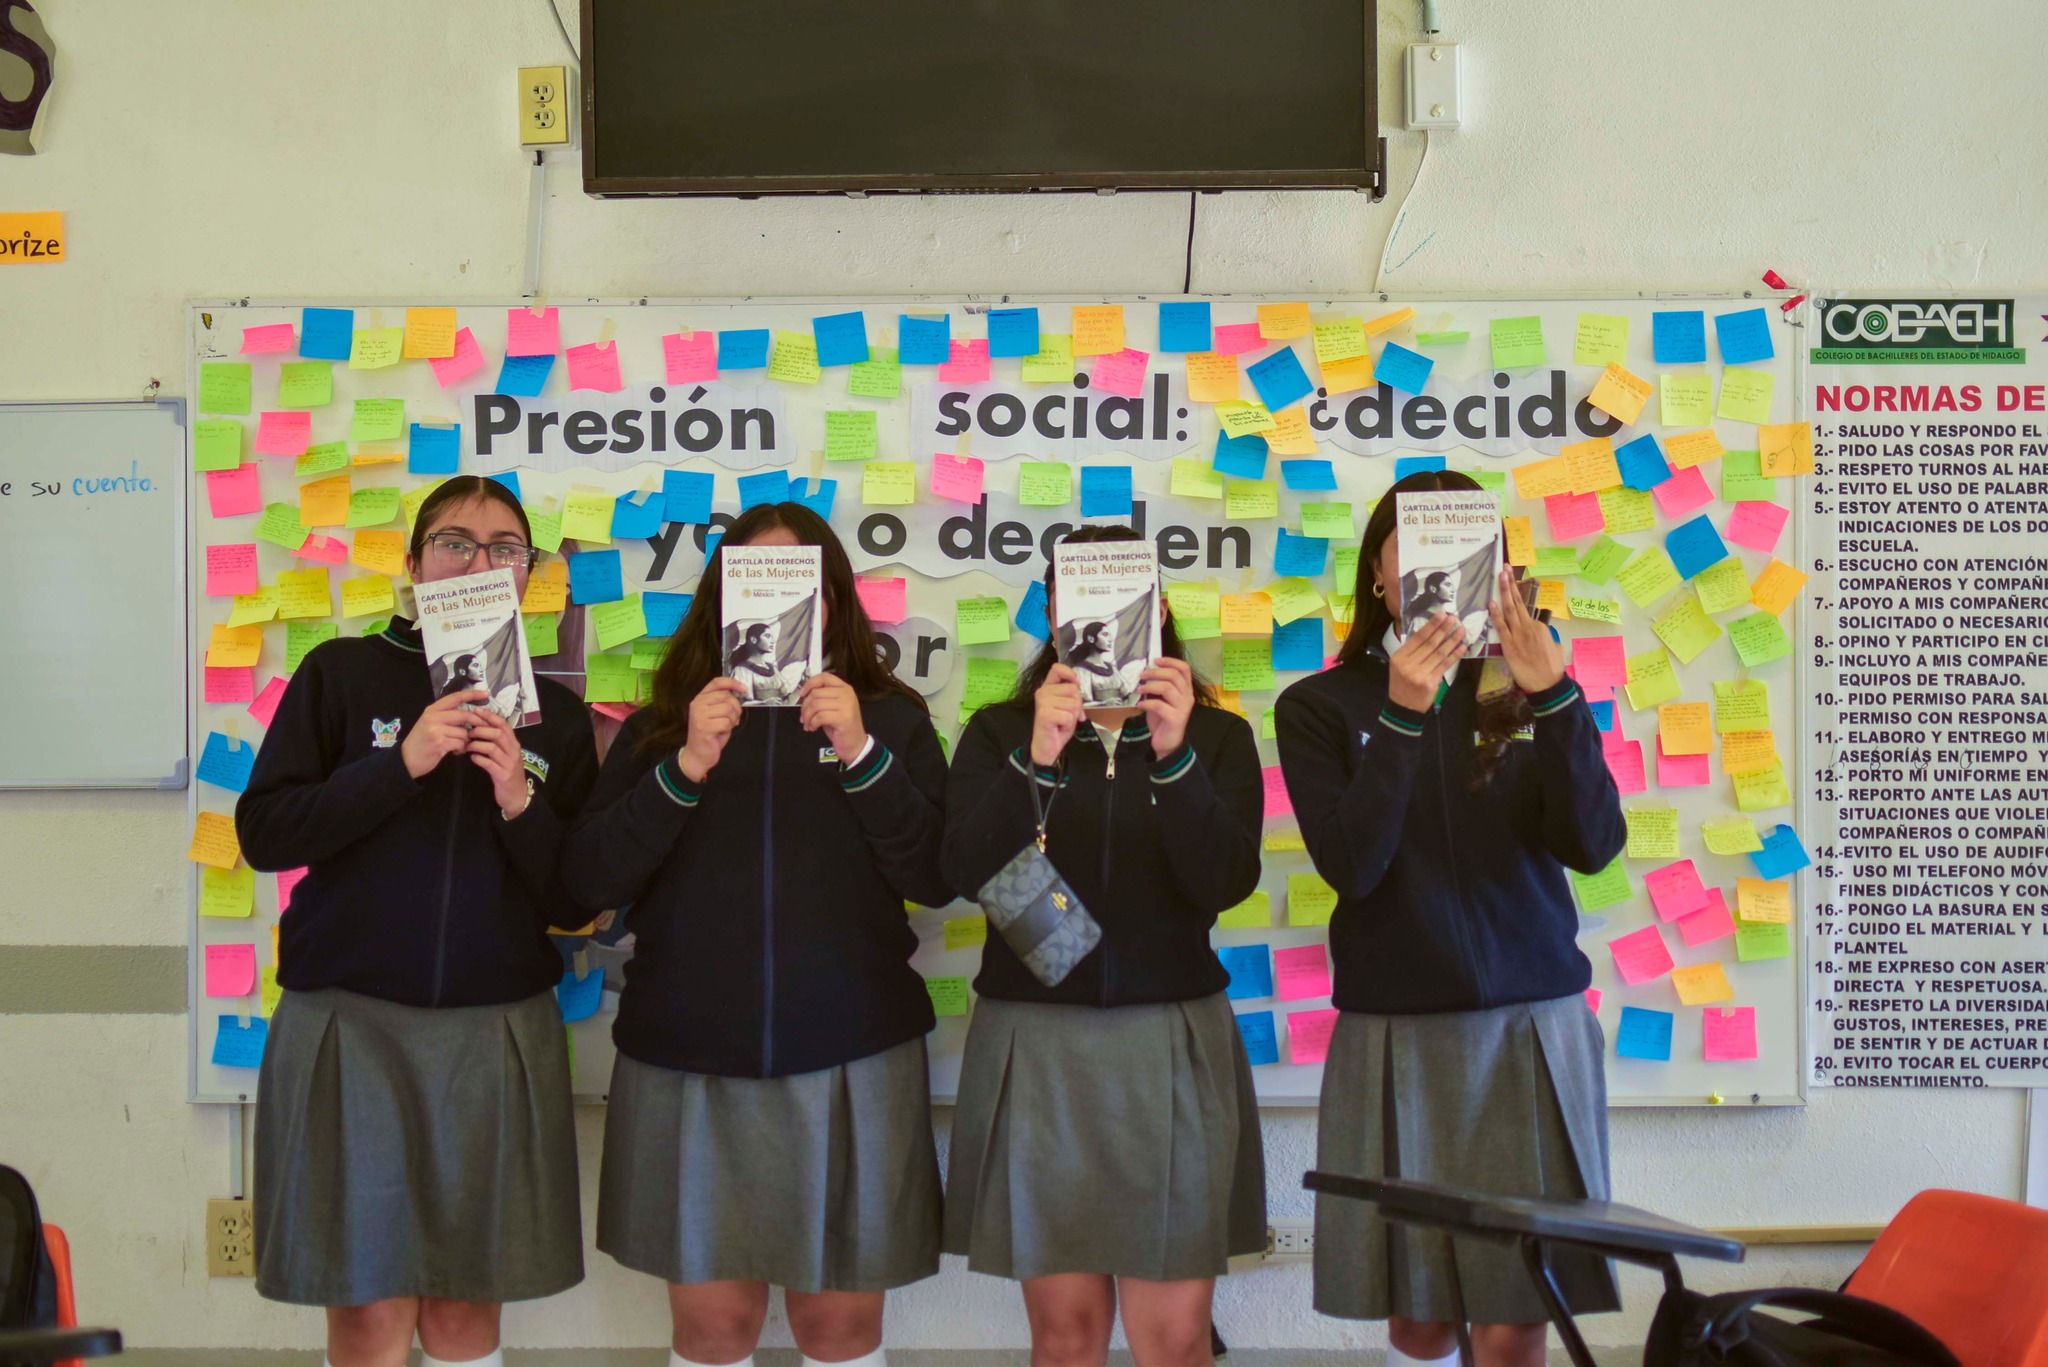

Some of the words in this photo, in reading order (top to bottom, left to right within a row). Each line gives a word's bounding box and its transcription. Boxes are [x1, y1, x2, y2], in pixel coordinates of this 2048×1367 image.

[1825, 303, 2006, 342] COBAEH
[1815, 351, 1853, 361] COLEGIO
[1855, 351, 1866, 361] DE
[1867, 351, 1918, 361] BACHILLERES
[1920, 351, 1935, 361] DEL
[1936, 351, 1968, 361] ESTADO
[1970, 351, 1981, 361] DE
[1982, 351, 2020, 361] HIDALGO
[1816, 385, 1982, 411] NORMAS
[1997, 385, 2046, 411] DE
[474, 385, 776, 455] Presión
[936, 372, 1188, 440] social:
[1310, 370, 1623, 440] ¿decido
[1838, 424, 1905, 438] SALUDO
[1909, 424, 1921, 438] Y
[1926, 424, 2017, 438] RESPONDO
[2022, 424, 2043, 438] EL
[1838, 443, 1878, 457] PIDO
[1882, 443, 1914, 457] LAS
[1919, 443, 1975, 457] COSAS
[1980, 443, 2014, 457] POR
[1838, 462, 1914, 476] RESPETO
[1918, 462, 1988, 476] TURNOS
[1992, 462, 2014, 476] AL
[31, 480, 61, 497] su
[72, 460, 157, 496] cuento.
[1838, 481, 1888, 496] EVITO
[1892, 482, 1913, 495] EL
[1918, 481, 1953, 496] USO
[1957, 481, 1980, 495] DE
[1403, 504, 1440, 512] CARTILLA
[1454, 503, 1495, 511] DERECHOS
[1838, 500, 1892, 515] ESTOY
[1896, 500, 1962, 515] ATENTO
[1967, 500, 1979, 515] O
[1403, 514, 1419, 525] de
[1423, 514, 1441, 524] las
[1445, 513, 1495, 526] Mujeres
[1838, 520, 1958, 534] INDICACIONES
[1963, 520, 1985, 534] DE
[1989, 520, 2022, 534] LOS
[857, 513, 907, 557] o
[1838, 539, 1919, 553] ESCUELA.
[1060, 555, 1097, 563] CARTILLA
[1111, 553, 1151, 561] DERECHOS
[1838, 558, 1918, 572] ESCUCHO
[1923, 558, 1959, 572] CON
[728, 568, 742, 578] de
[746, 568, 763, 578] las
[766, 567, 815, 580] Mujeres
[1061, 565, 1076, 576] de
[1080, 564, 1098, 575] las
[1102, 563, 1152, 576] Mujeres
[1838, 575, 1953, 591] COMPAÑEROS
[1957, 577, 1969, 591] Y
[421, 591, 458, 602] CARTILLA
[459, 588, 469, 596] DE
[470, 581, 510, 594] DERECHOS
[423, 603, 438, 615] de
[442, 600, 460, 612] las
[463, 591, 511, 609] Mujeres
[1571, 597, 1583, 607] Sal
[1585, 599, 1596, 610] de
[1598, 600, 1610, 612] las
[1838, 596, 1894, 610] APOYO
[1898, 596, 1910, 610] A
[1915, 596, 1945, 610] MIS
[1838, 615, 1938, 629] SOLICITADO
[1942, 615, 1955, 629] O
[1838, 634, 1891, 649] OPINO
[1895, 634, 1907, 648] Y
[1912, 634, 2000, 649] PARTICIPO
[2004, 634, 2027, 648] EN
[1839, 654, 1911, 668] INCLUYO
[1915, 654, 1928, 667] A
[1932, 653, 1963, 668] MIS
[1839, 673, 1912, 687] EQUIPOS
[1916, 673, 1939, 687] DE
[1943, 673, 2026, 687] TRABAJO.
[1848, 692, 1888, 706] PIDO
[1892, 692, 1967, 706] PERMISO
[1972, 692, 2016, 706] PARA
[1839, 711, 1913, 725] PERMISO
[1917, 711, 1953, 725] CON
[1848, 730, 1926, 744] ELABORO
[1930, 730, 1943, 744] Y
[1947, 730, 2027, 744] ENTREGO
[1838, 748, 1933, 764] ASESORÍAS
[1937, 750, 1960, 764] EN
[1964, 750, 2029, 764] TIEMPO
[1848, 769, 1905, 783] PORTO
[1909, 769, 1929, 783] MI
[1933, 769, 2022, 783] UNIFORME
[1848, 788, 1926, 802] REPORTO
[1930, 788, 1975, 802] ANTE
[1980, 788, 2012, 802] LAS
[1838, 807, 1950, 821] SITUACIONES
[1954, 807, 1990, 821] QUE
[1838, 824, 1953, 840] COMPAÑEROS
[1957, 826, 1970, 840] O
[1815, 845, 1893, 859] 14.-EVITO
[1898, 845, 1919, 859] EL
[1925, 845, 1960, 859] USO
[1965, 845, 1988, 859] DE
[1852, 864, 1888, 878] USO
[1892, 864, 1912, 878] MI
[1916, 864, 2006, 878] TELEFONO
[1839, 883, 1887, 897] FINES
[1892, 883, 1994, 898] DIDÁCTICOS
[1998, 884, 2011, 897] Y
[1848, 903, 1907, 917] PONGO
[1912, 903, 1934, 916] LA
[1938, 903, 2008, 917] BASURA
[2012, 903, 2035, 917] EN
[1847, 922, 1901, 936] CUIDO
[1906, 922, 1926, 936] EL
[1931, 922, 2016, 936] MATERIAL
[2020, 922, 2033, 936] Y
[1834, 941, 1909, 955] PLANTEL
[1848, 960, 1873, 974] ME
[1877, 960, 1955, 974] EXPRESO
[1959, 960, 1996, 974] CON
[1833, 979, 1905, 993] DIRECTA
[1914, 979, 1926, 993] Y
[1931, 979, 2048, 994] RESPETUOSA.
[1848, 998, 1924, 1012] RESPETO
[1929, 998, 1951, 1012] LA
[1833, 1017, 1906, 1032] GUSTOS,
[1911, 1018, 2010, 1032] INTERESES,
[2014, 1018, 2047, 1032] PRE
[1833, 1037, 1855, 1050] DE
[1860, 1037, 1922, 1051] SENTIR
[1926, 1037, 1938, 1050] Y
[1943, 1037, 1965, 1051] DE
[1969, 1037, 2038, 1051] ACTUAR
[1843, 1056, 1893, 1070] EVITO
[1897, 1056, 1955, 1070] TOCAR
[1960, 1056, 1981, 1070] EL
[1832, 1075, 1989, 1089] CONSENTIMIENTO.
